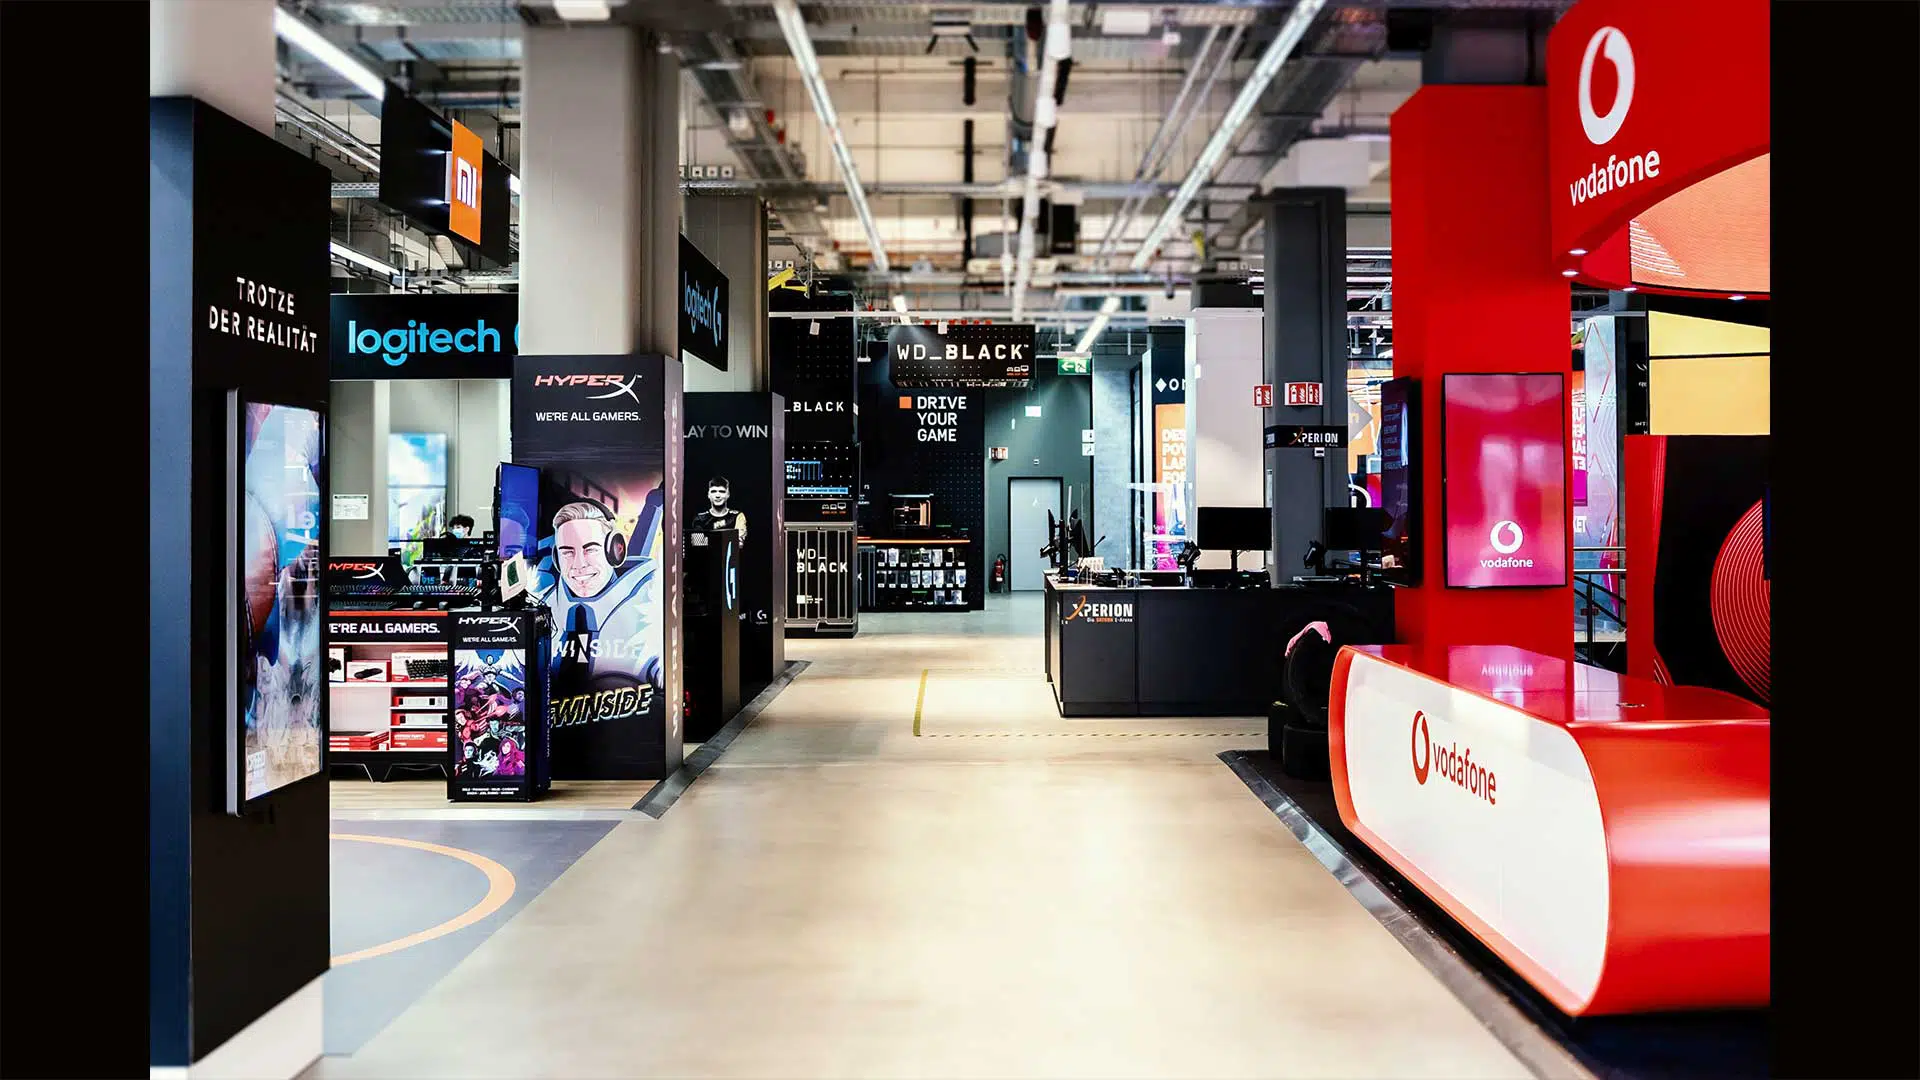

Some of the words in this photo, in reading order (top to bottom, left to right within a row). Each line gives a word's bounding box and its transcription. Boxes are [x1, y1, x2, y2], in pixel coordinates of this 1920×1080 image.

[1570, 150, 1660, 206] vodafone
[236, 276, 295, 315] TROTZE
[208, 305, 241, 336] DER
[247, 315, 318, 353] REALITÄT
[348, 319, 500, 366] logitech
[916, 396, 967, 410] DRIVE
[535, 411, 569, 422] WE'RE
[570, 411, 591, 422] ALL
[592, 411, 641, 422] GAMERS.
[916, 412, 958, 426] YOUR
[710, 425, 732, 438] TO
[735, 425, 769, 438] WIN
[916, 428, 957, 442] GAME
[1288, 426, 1339, 445] XPERION
[796, 562, 848, 573] BLACK
[1480, 557, 1534, 568] vodafone
[1065, 595, 1133, 617] XPERION
[329, 623, 358, 634] E'RE
[359, 623, 384, 634] ALL
[385, 623, 441, 634] GAMERS.
[1432, 742, 1497, 805] vodafone
